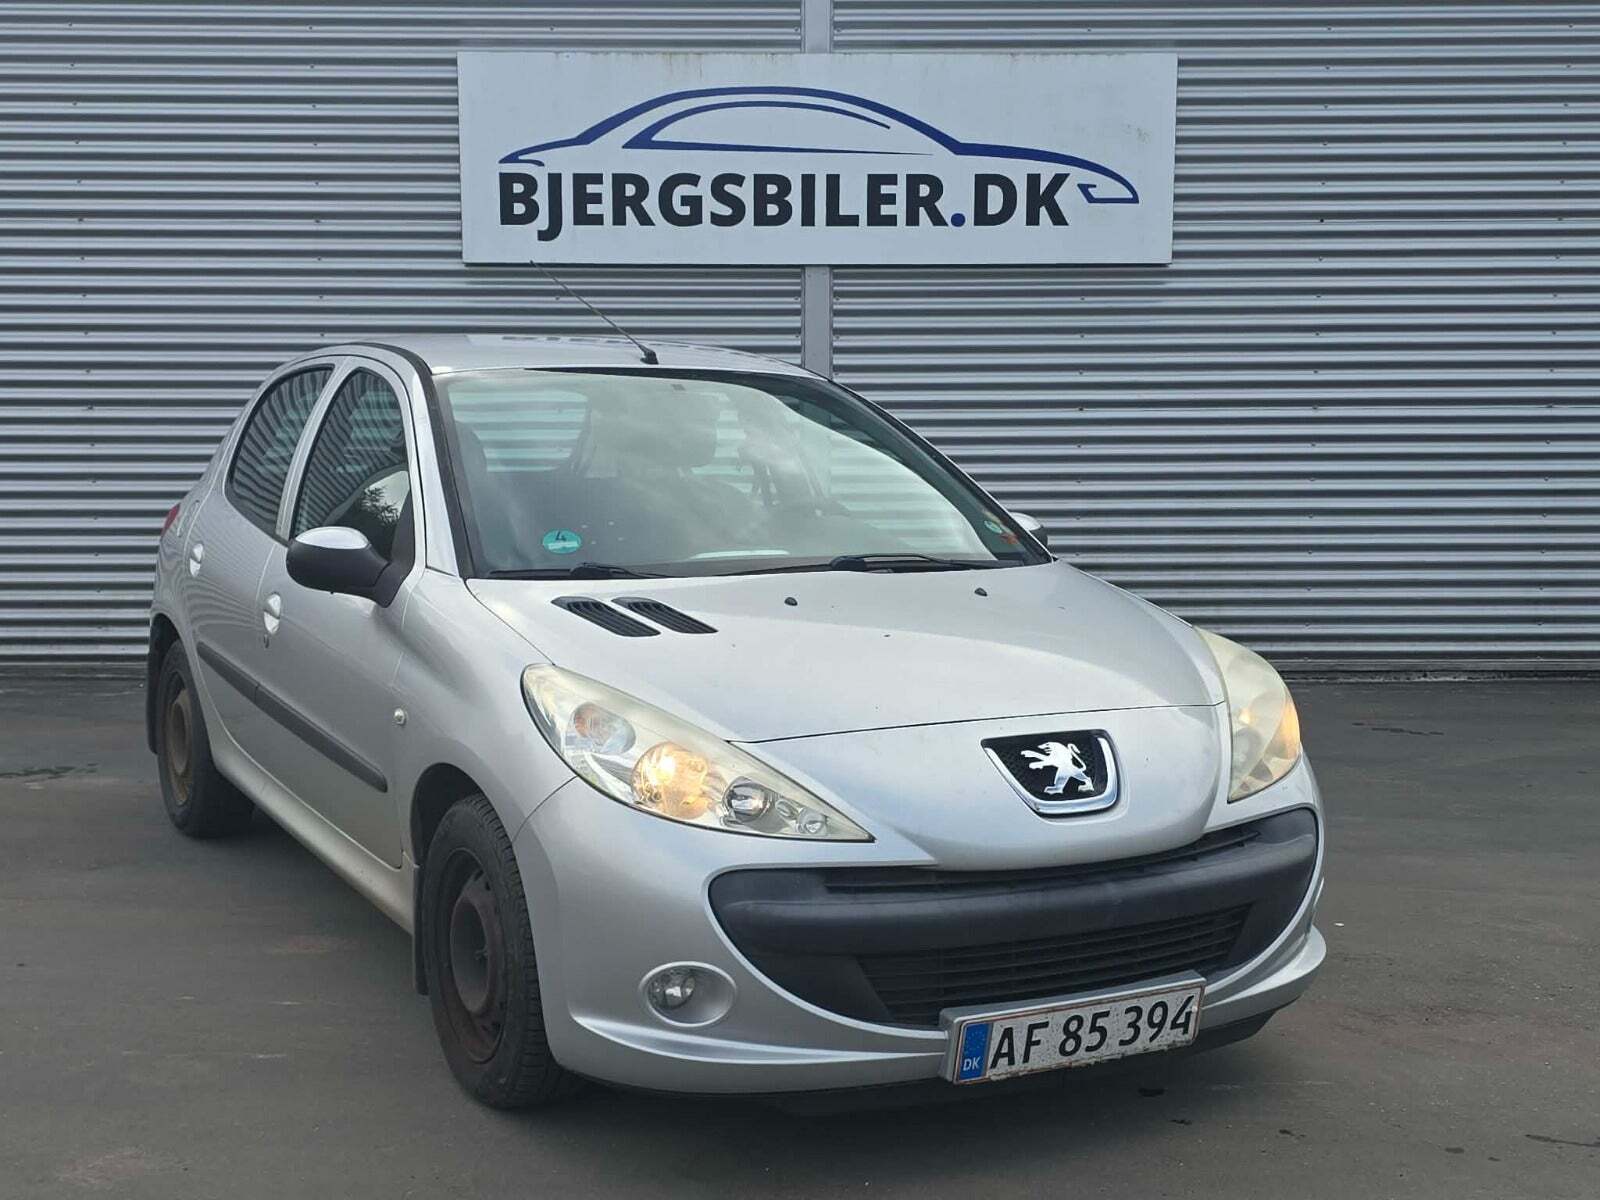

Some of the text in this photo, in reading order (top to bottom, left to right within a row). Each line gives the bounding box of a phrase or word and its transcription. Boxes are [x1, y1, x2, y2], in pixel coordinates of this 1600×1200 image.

[499, 172, 1070, 242] BJERGSBILER.DK
[963, 1056, 980, 1071] DK
[990, 995, 1195, 1069] AF 85 394
